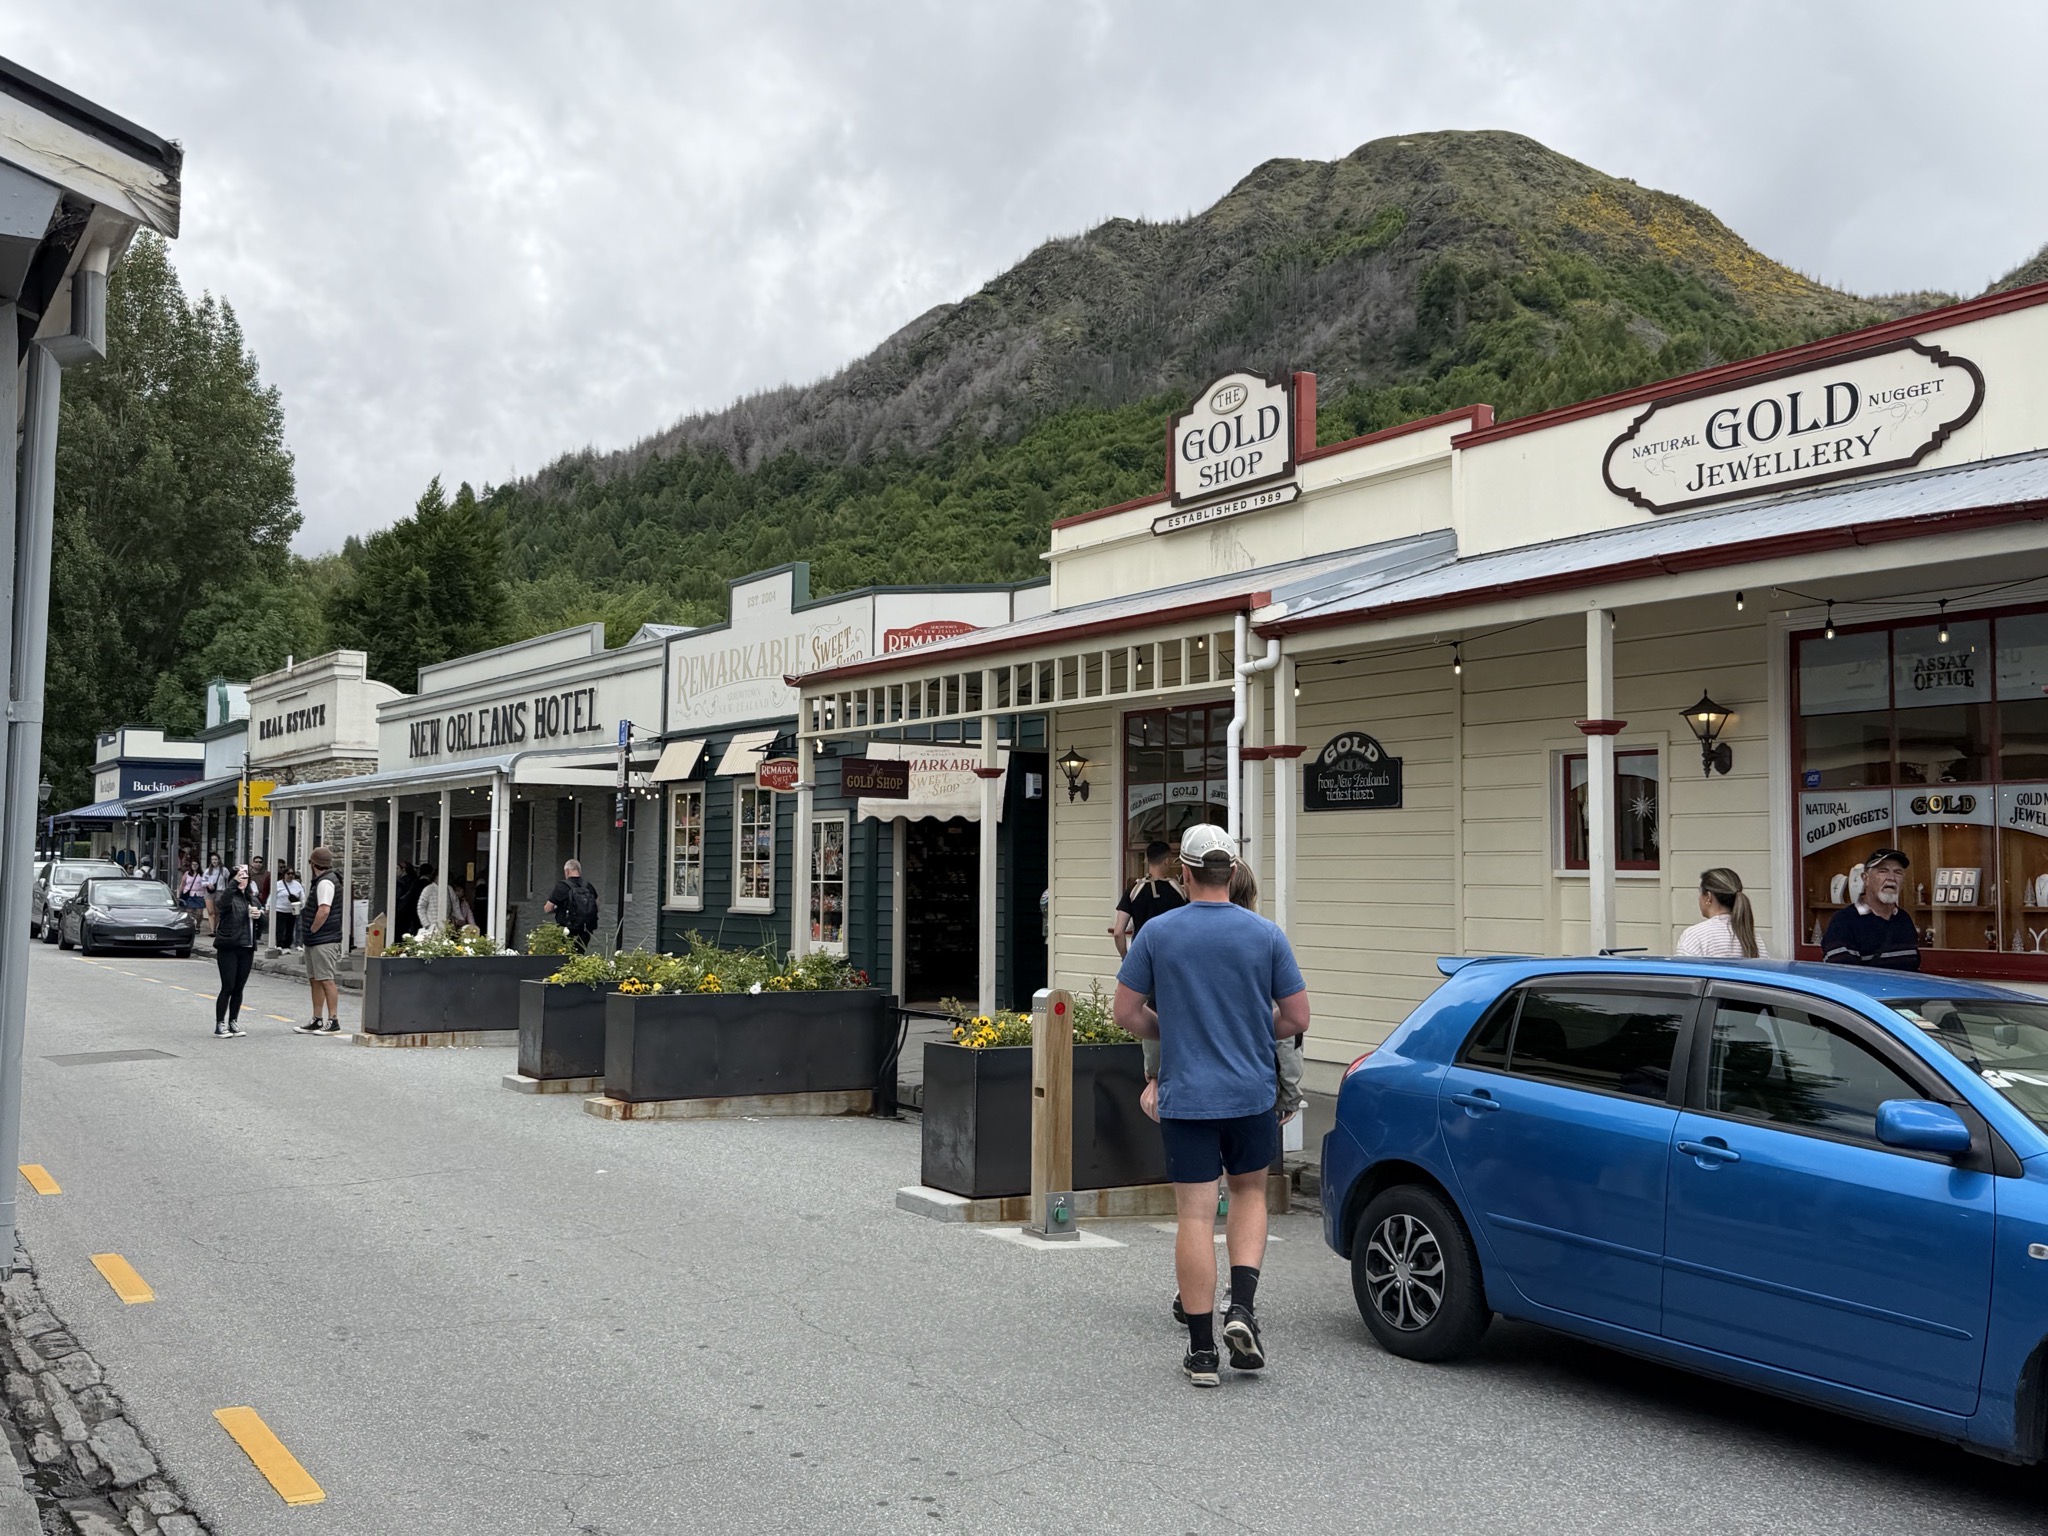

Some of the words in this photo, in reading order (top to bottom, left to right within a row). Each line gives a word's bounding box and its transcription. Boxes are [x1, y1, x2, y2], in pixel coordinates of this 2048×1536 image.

[1217, 388, 1241, 408] THE
[1632, 434, 1700, 459] NATURAL
[1705, 381, 1861, 451] GOLD
[1868, 378, 1945, 407] NUGGET
[1182, 405, 1281, 463] GOLD
[1199, 450, 1263, 488] SHOP
[1686, 425, 1883, 492] JEWELLERY
[1168, 500, 1247, 528] ESTABLISHED
[1254, 492, 1281, 506] 1989
[761, 590, 776, 607] 2004
[677, 633, 806, 711] REMARKABLE
[1914, 653, 1970, 673] ASSAY
[1914, 669, 1974, 691] OFFICE
[259, 715, 284, 741] REAL
[286, 703, 326, 734] ESTATE
[409, 718, 441, 759] NEW
[446, 701, 527, 753] ORLEANS
[534, 687, 602, 740] HOTEL
[1324, 736, 1379, 764] GOLD
[761, 764, 798, 777] REMARKA
[867, 763, 885, 778] The
[847, 775, 874, 789] GOLD
[876, 776, 904, 790] SHOP
[1172, 786, 1199, 797] GOLD
[1805, 801, 1850, 817] NATURAL
[1911, 795, 1976, 815] GOLD
[2016, 792, 2043, 806] GOLD
[1806, 822, 1837, 844] GOLD
[1837, 807, 1889, 832] NUGGETS
